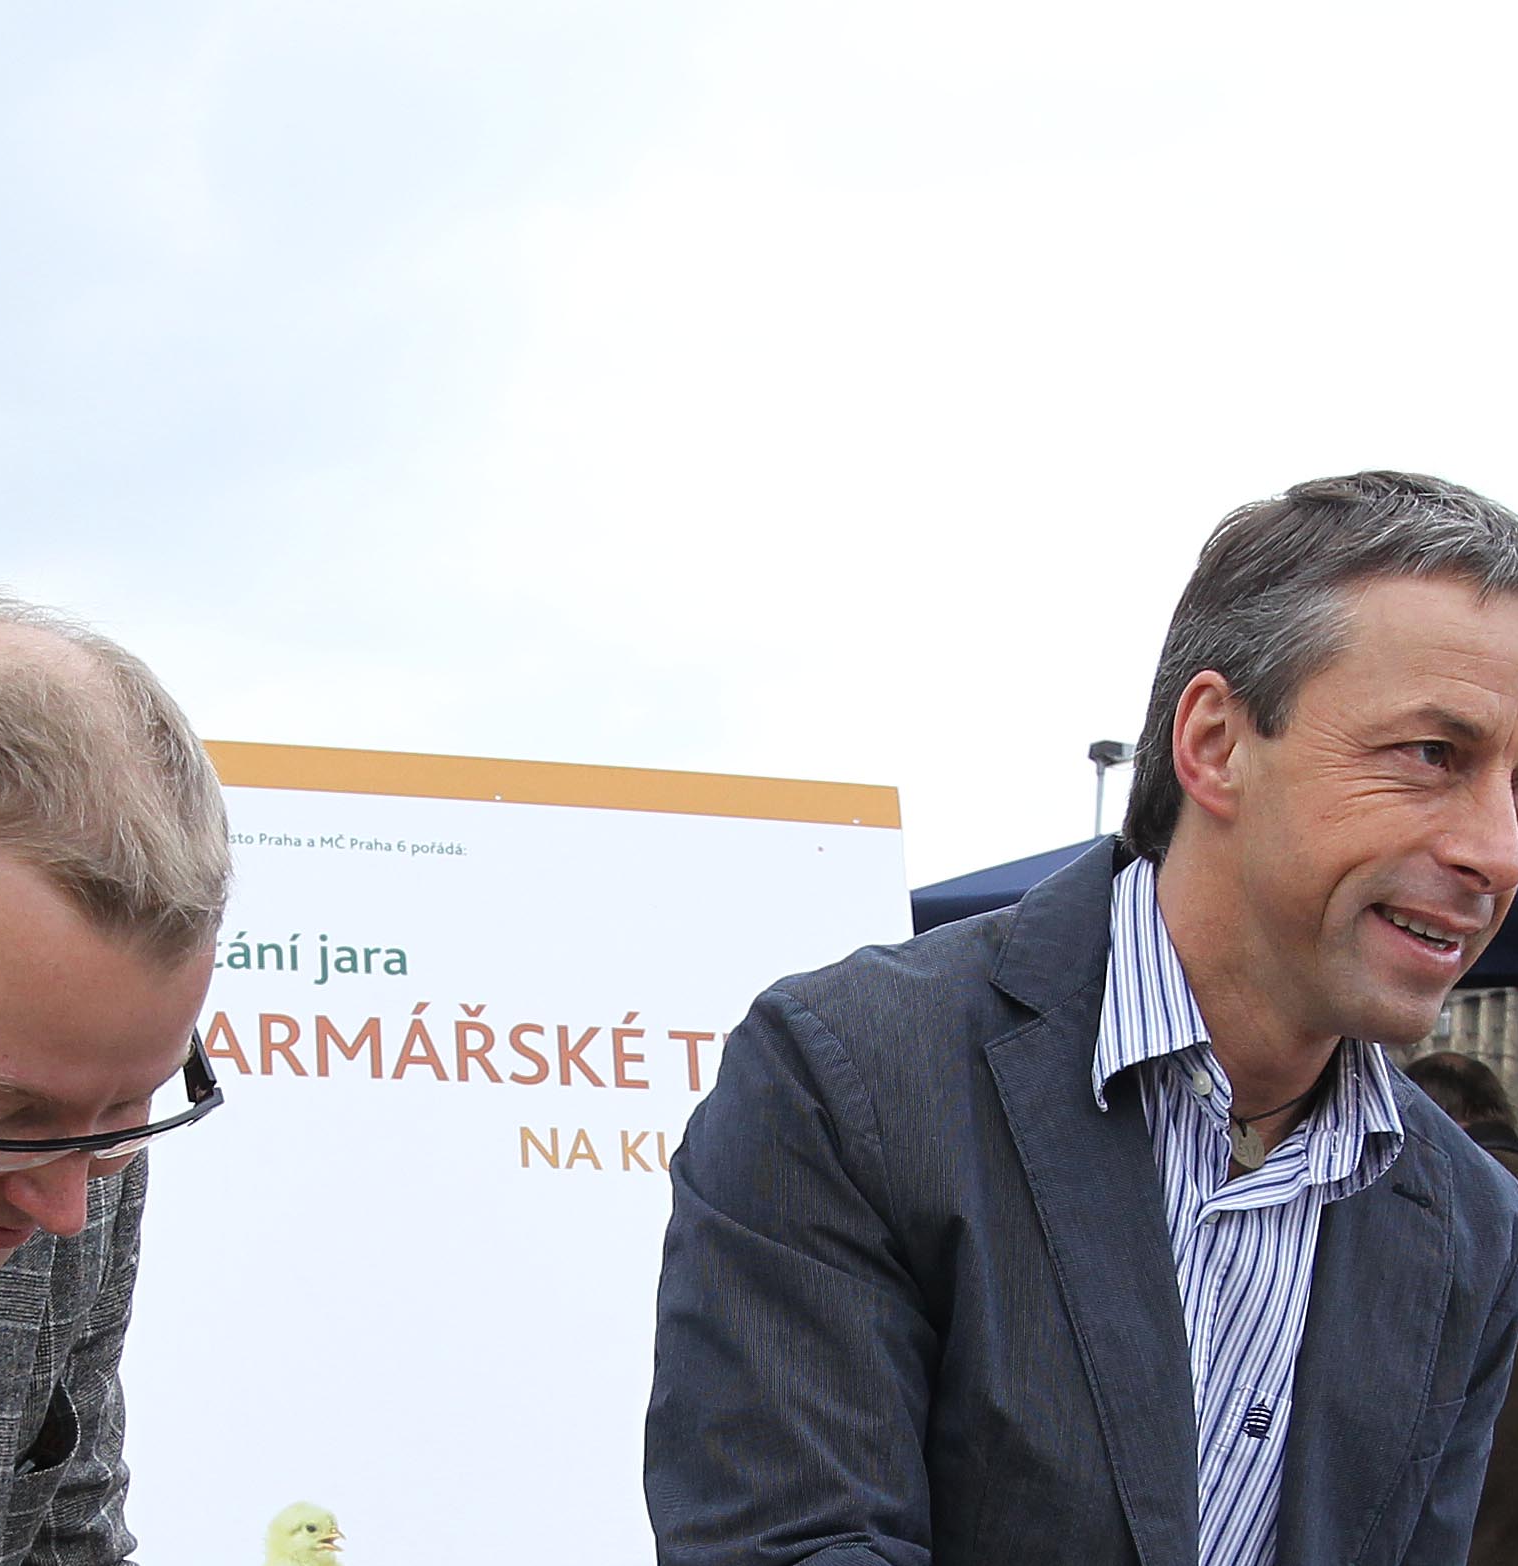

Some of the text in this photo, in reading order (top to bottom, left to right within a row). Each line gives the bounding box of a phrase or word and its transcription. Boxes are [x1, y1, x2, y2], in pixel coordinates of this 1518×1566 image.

[228, 832, 468, 857] sto Praha a MČ Praha 6 pořádá:
[313, 933, 409, 986] jara
[204, 1001, 730, 1092] ARMÁŘSKÉ T
[518, 1126, 603, 1171] NA
